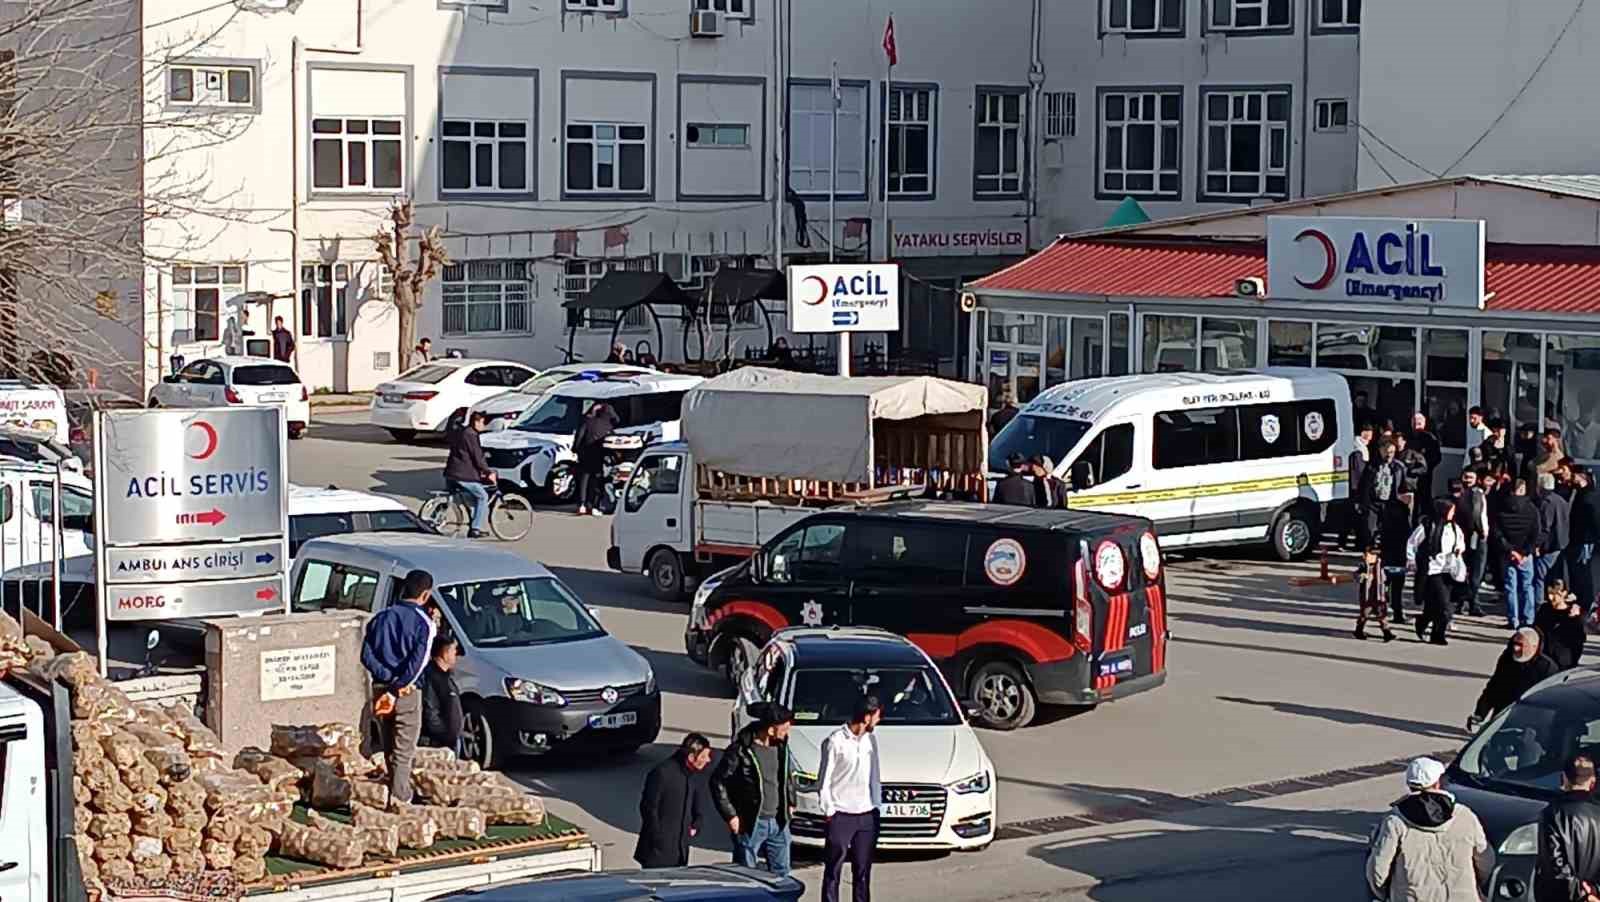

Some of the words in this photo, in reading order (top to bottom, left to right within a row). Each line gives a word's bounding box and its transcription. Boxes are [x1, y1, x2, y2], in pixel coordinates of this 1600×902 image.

[894, 232, 950, 247] YATAKLI
[953, 229, 1022, 246] SERVİSLER
[1345, 223, 1443, 276] ACİL
[833, 270, 888, 296] ACİL
[127, 471, 182, 498] ACİL
[189, 466, 269, 496] SERVİS
